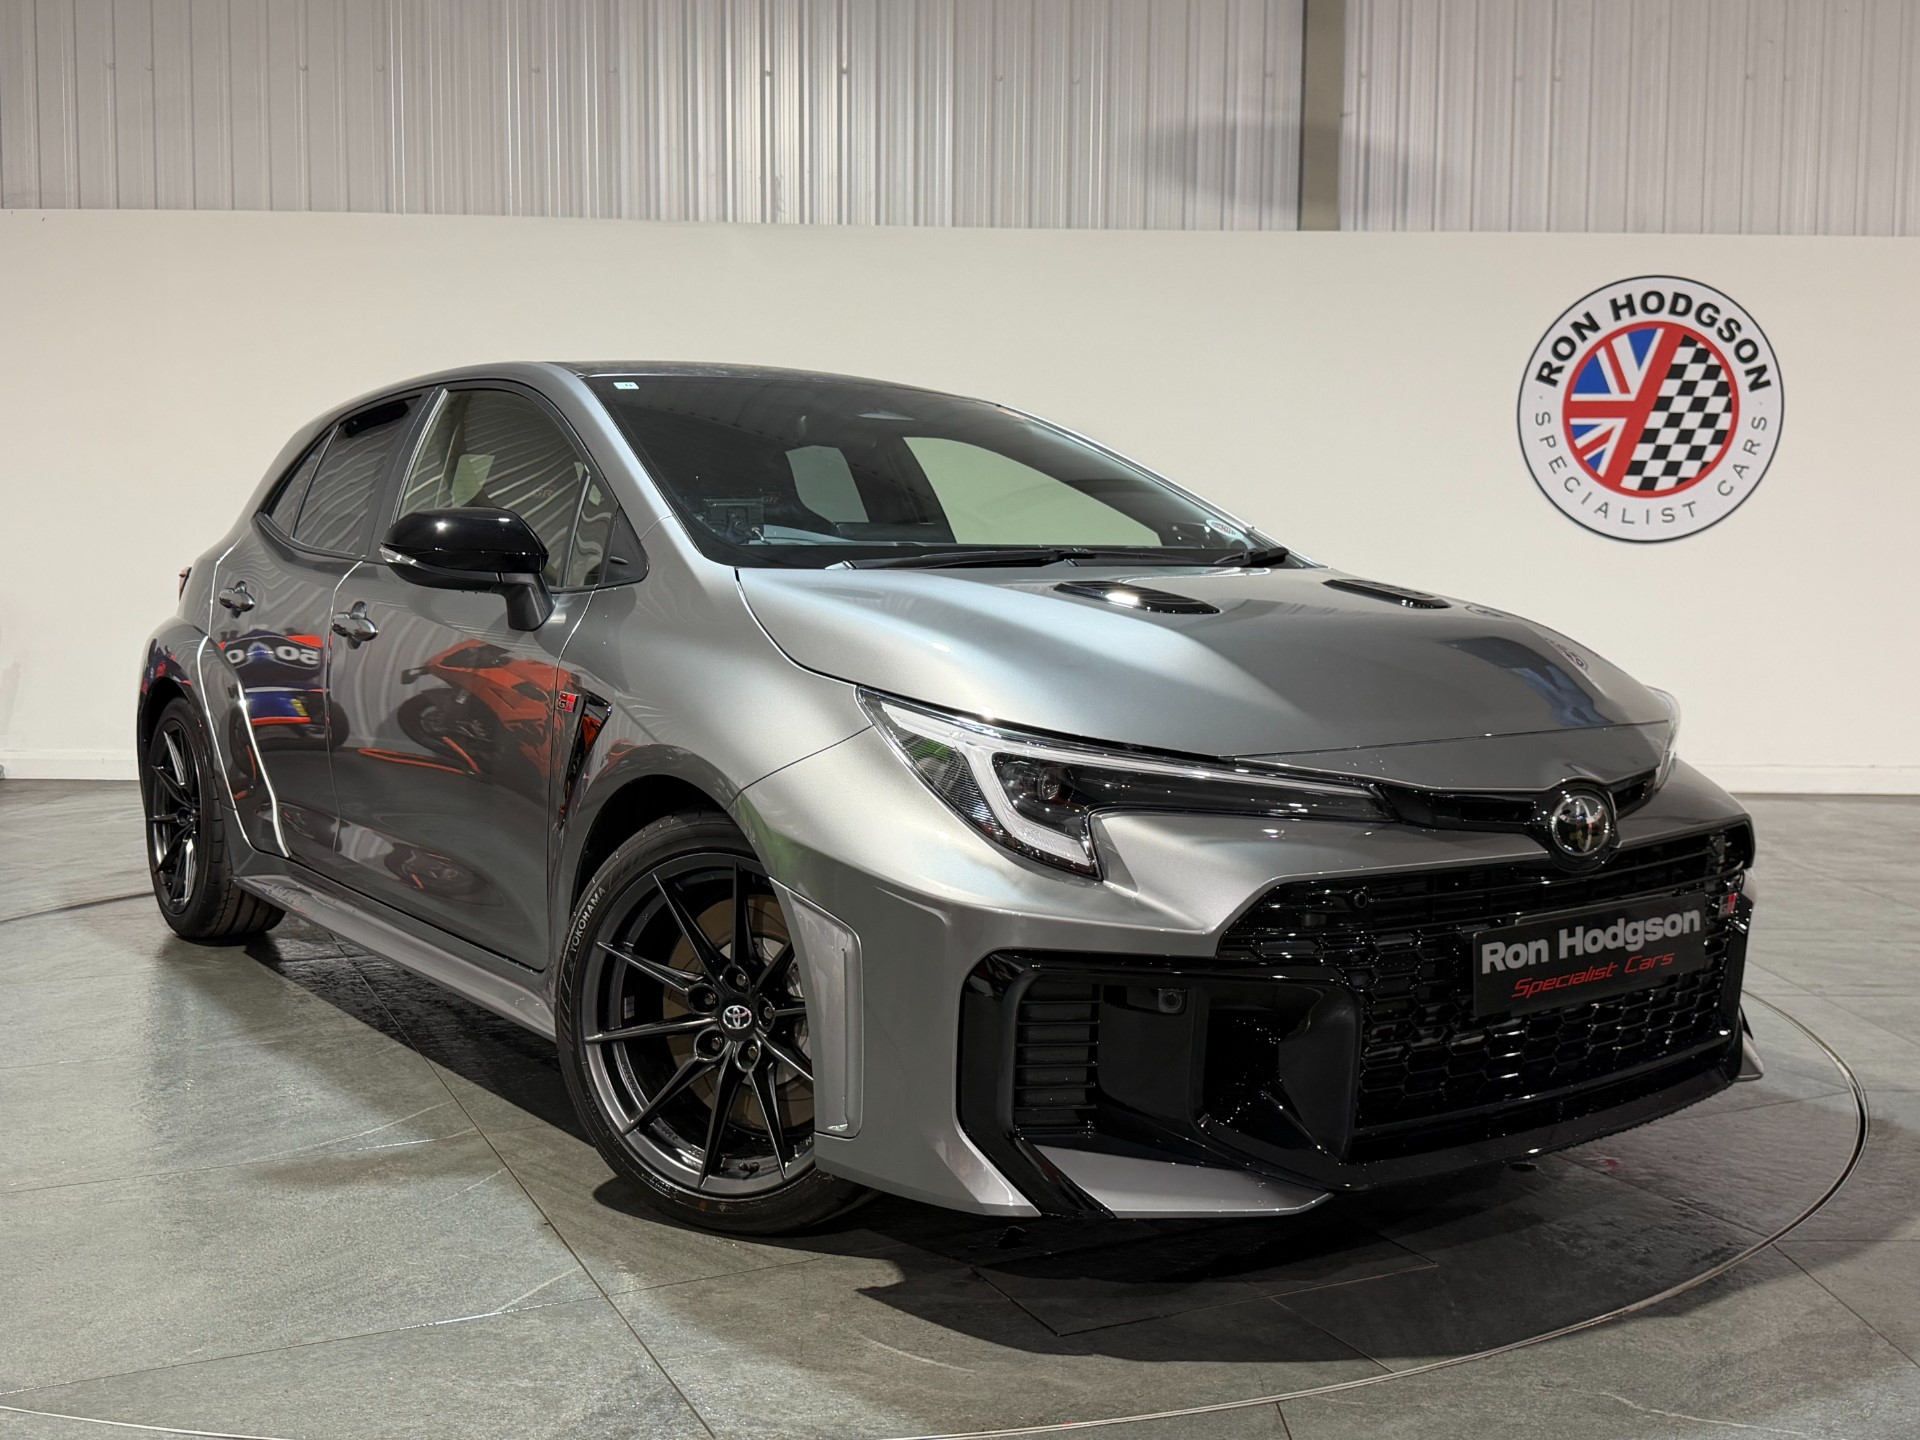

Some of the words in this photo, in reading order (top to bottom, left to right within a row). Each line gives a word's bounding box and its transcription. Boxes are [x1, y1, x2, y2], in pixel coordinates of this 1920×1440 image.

[1535, 310, 1601, 388] RON
[1608, 290, 1773, 393] HODGSON
[1534, 410, 1697, 525] SPECIALIST
[1716, 415, 1769, 498] CARS
[570, 887, 606, 953] YOKOHAMA
[1481, 938, 1550, 975] Ron
[1558, 908, 1701, 960] Hodgson
[1510, 961, 1618, 999] Specialist
[1624, 952, 1676, 975] Cars
